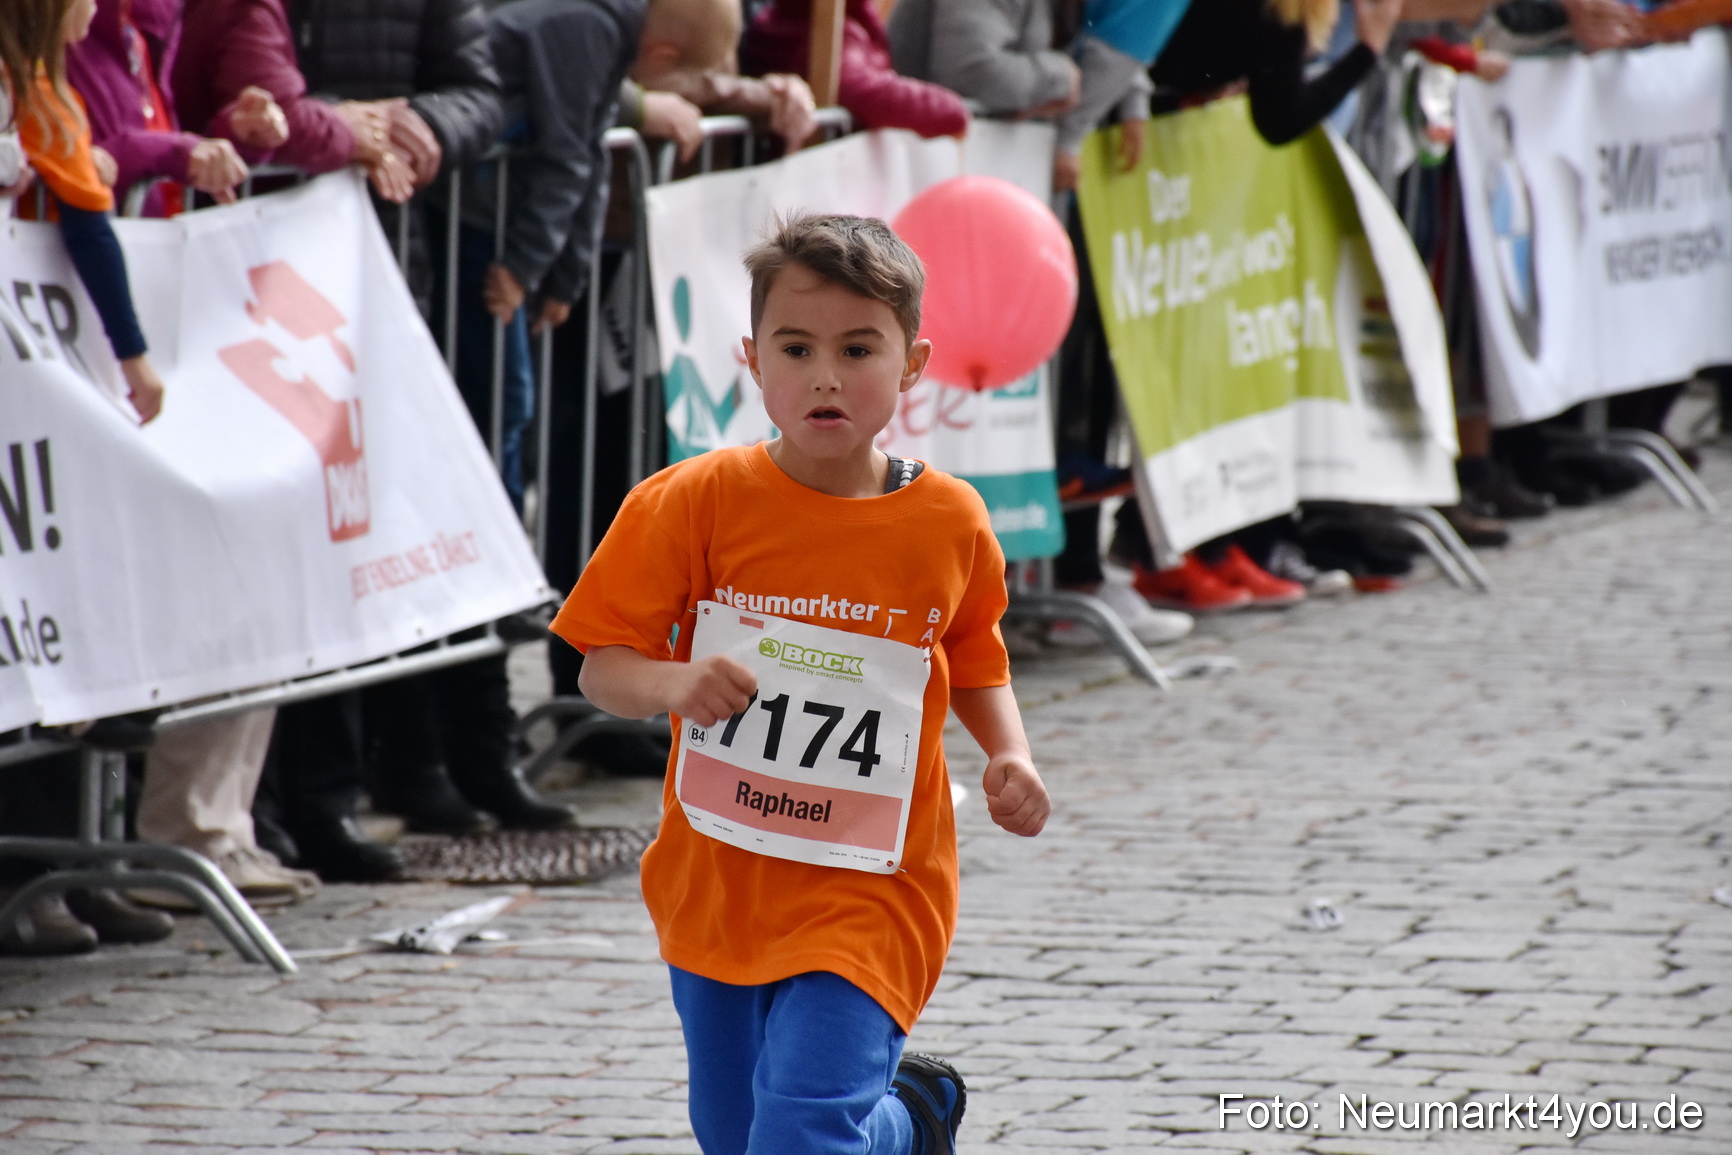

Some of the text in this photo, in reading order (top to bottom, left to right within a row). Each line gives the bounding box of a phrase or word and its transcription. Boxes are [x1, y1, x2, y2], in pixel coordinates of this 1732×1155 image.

[1147, 169, 1191, 226] Der
[715, 585, 880, 622] Neumarkter
[779, 661, 864, 684] inspired by smart concepts
[781, 642, 865, 677] BOCK
[690, 726, 706, 744] B4
[735, 780, 833, 824] Raphael
